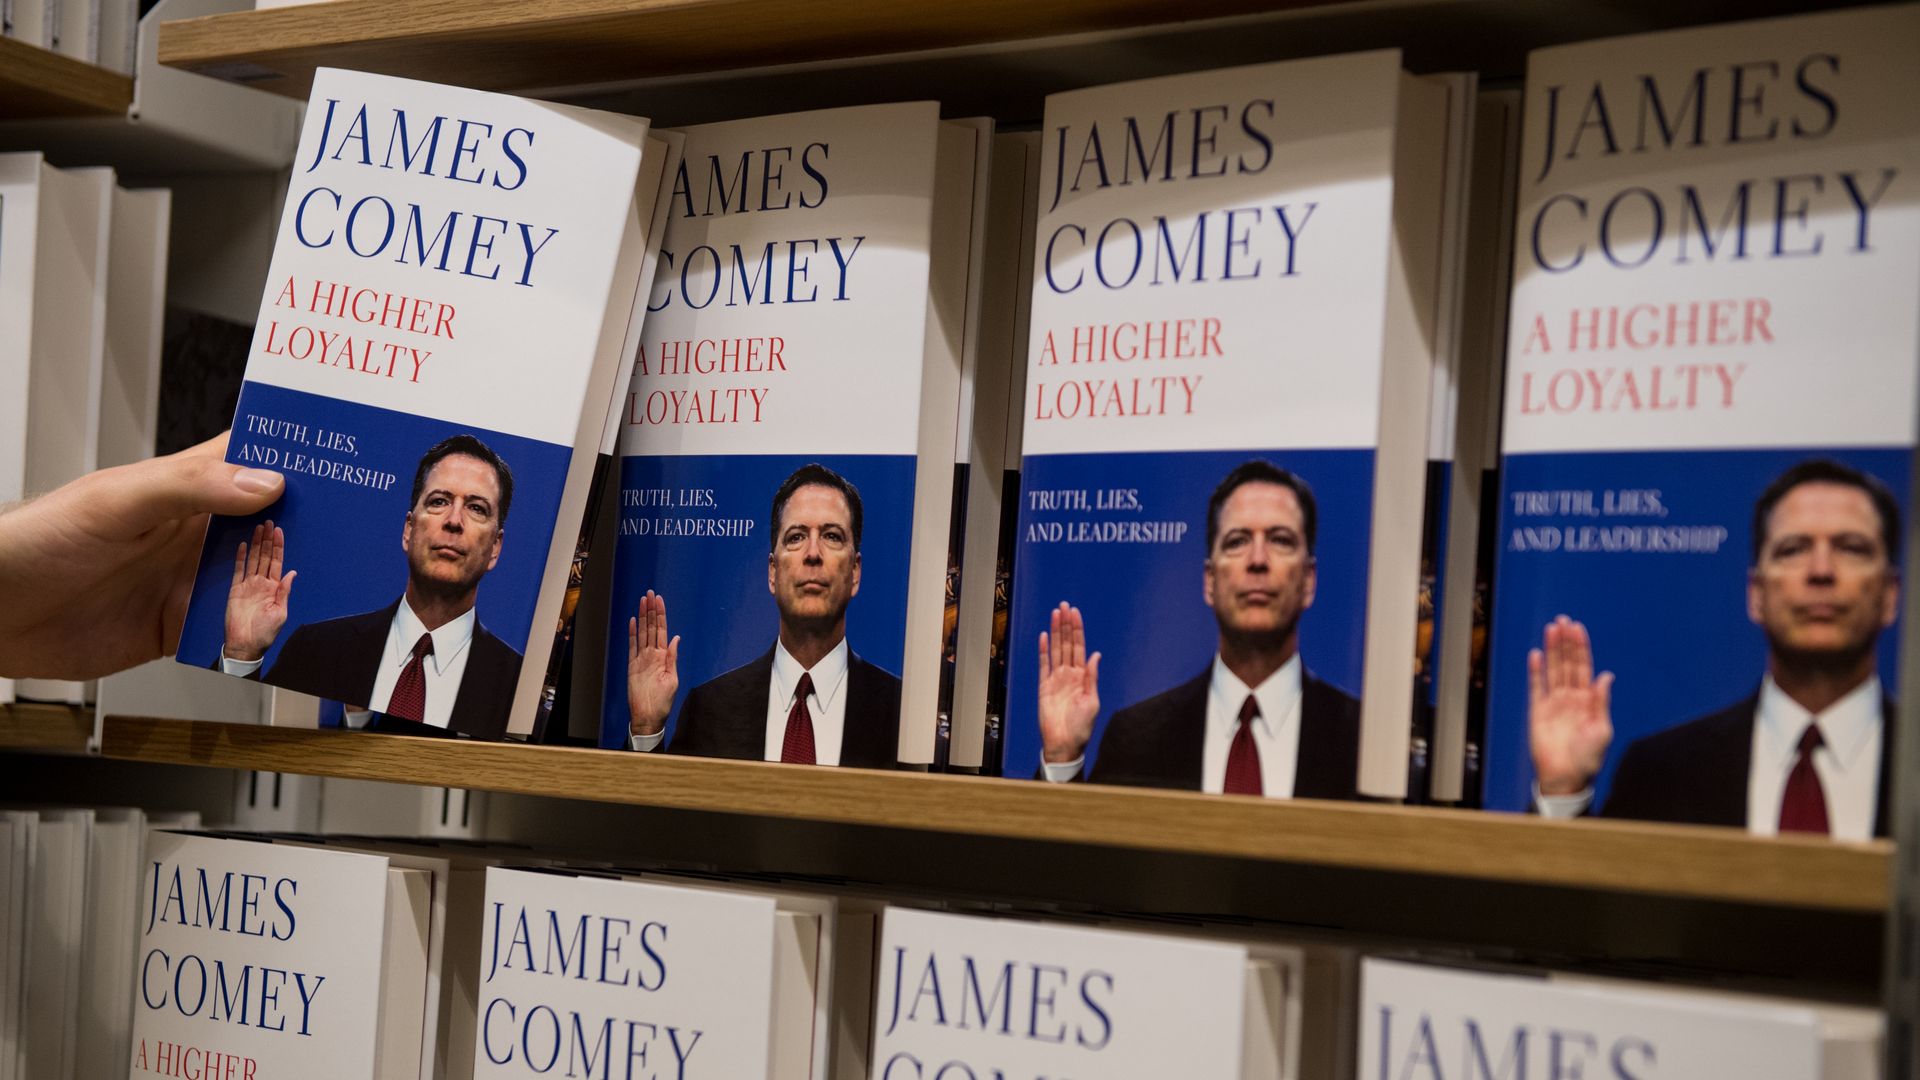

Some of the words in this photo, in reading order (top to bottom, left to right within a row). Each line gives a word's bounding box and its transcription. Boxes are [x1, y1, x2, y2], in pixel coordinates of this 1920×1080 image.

[306, 98, 535, 190] JAMES
[1536, 53, 1841, 184] JAMES
[670, 142, 829, 218] AMES
[1049, 99, 1275, 213] JAMES
[295, 186, 559, 287] COMEY
[1044, 202, 1318, 295] COMEY
[1531, 167, 1898, 274] COMEY
[275, 275, 297, 309] A
[309, 279, 456, 339] HIGHER
[1522, 313, 1553, 355] A
[1567, 297, 1775, 354] HIGHER
[264, 321, 432, 384] LOYALTY
[632, 343, 650, 376] A
[659, 336, 787, 376] HIGHER
[1038, 329, 1059, 366] A
[1071, 317, 1224, 364] HIGHER
[628, 388, 769, 426] LOYALTY
[1034, 375, 1203, 421] LOYALTY
[1519, 362, 1747, 416] LOYALTY
[238, 443, 278, 466] AND
[283, 451, 396, 491] LEADERSHIP
[247, 414, 310, 447] TRUTH,
[315, 429, 359, 457] LIES,
[619, 518, 650, 536] AND
[654, 518, 755, 537] LEADERSHIP
[622, 489, 675, 510] TRUTH,
[679, 489, 718, 510] LIES,
[1028, 489, 1092, 512] TRUTH,
[1096, 488, 1144, 512] LIES,
[1025, 522, 1064, 543] AND
[1067, 521, 1188, 544] LEADERSHIP
[146, 861, 298, 941] JAMES
[486, 901, 667, 992] JAMES
[142, 948, 326, 1037] COMEY
[885, 945, 1115, 1051] JAMES
[135, 1037, 149, 1071] A
[155, 1040, 257, 1080] HIGHER
[483, 997, 703, 1080] COMEY
